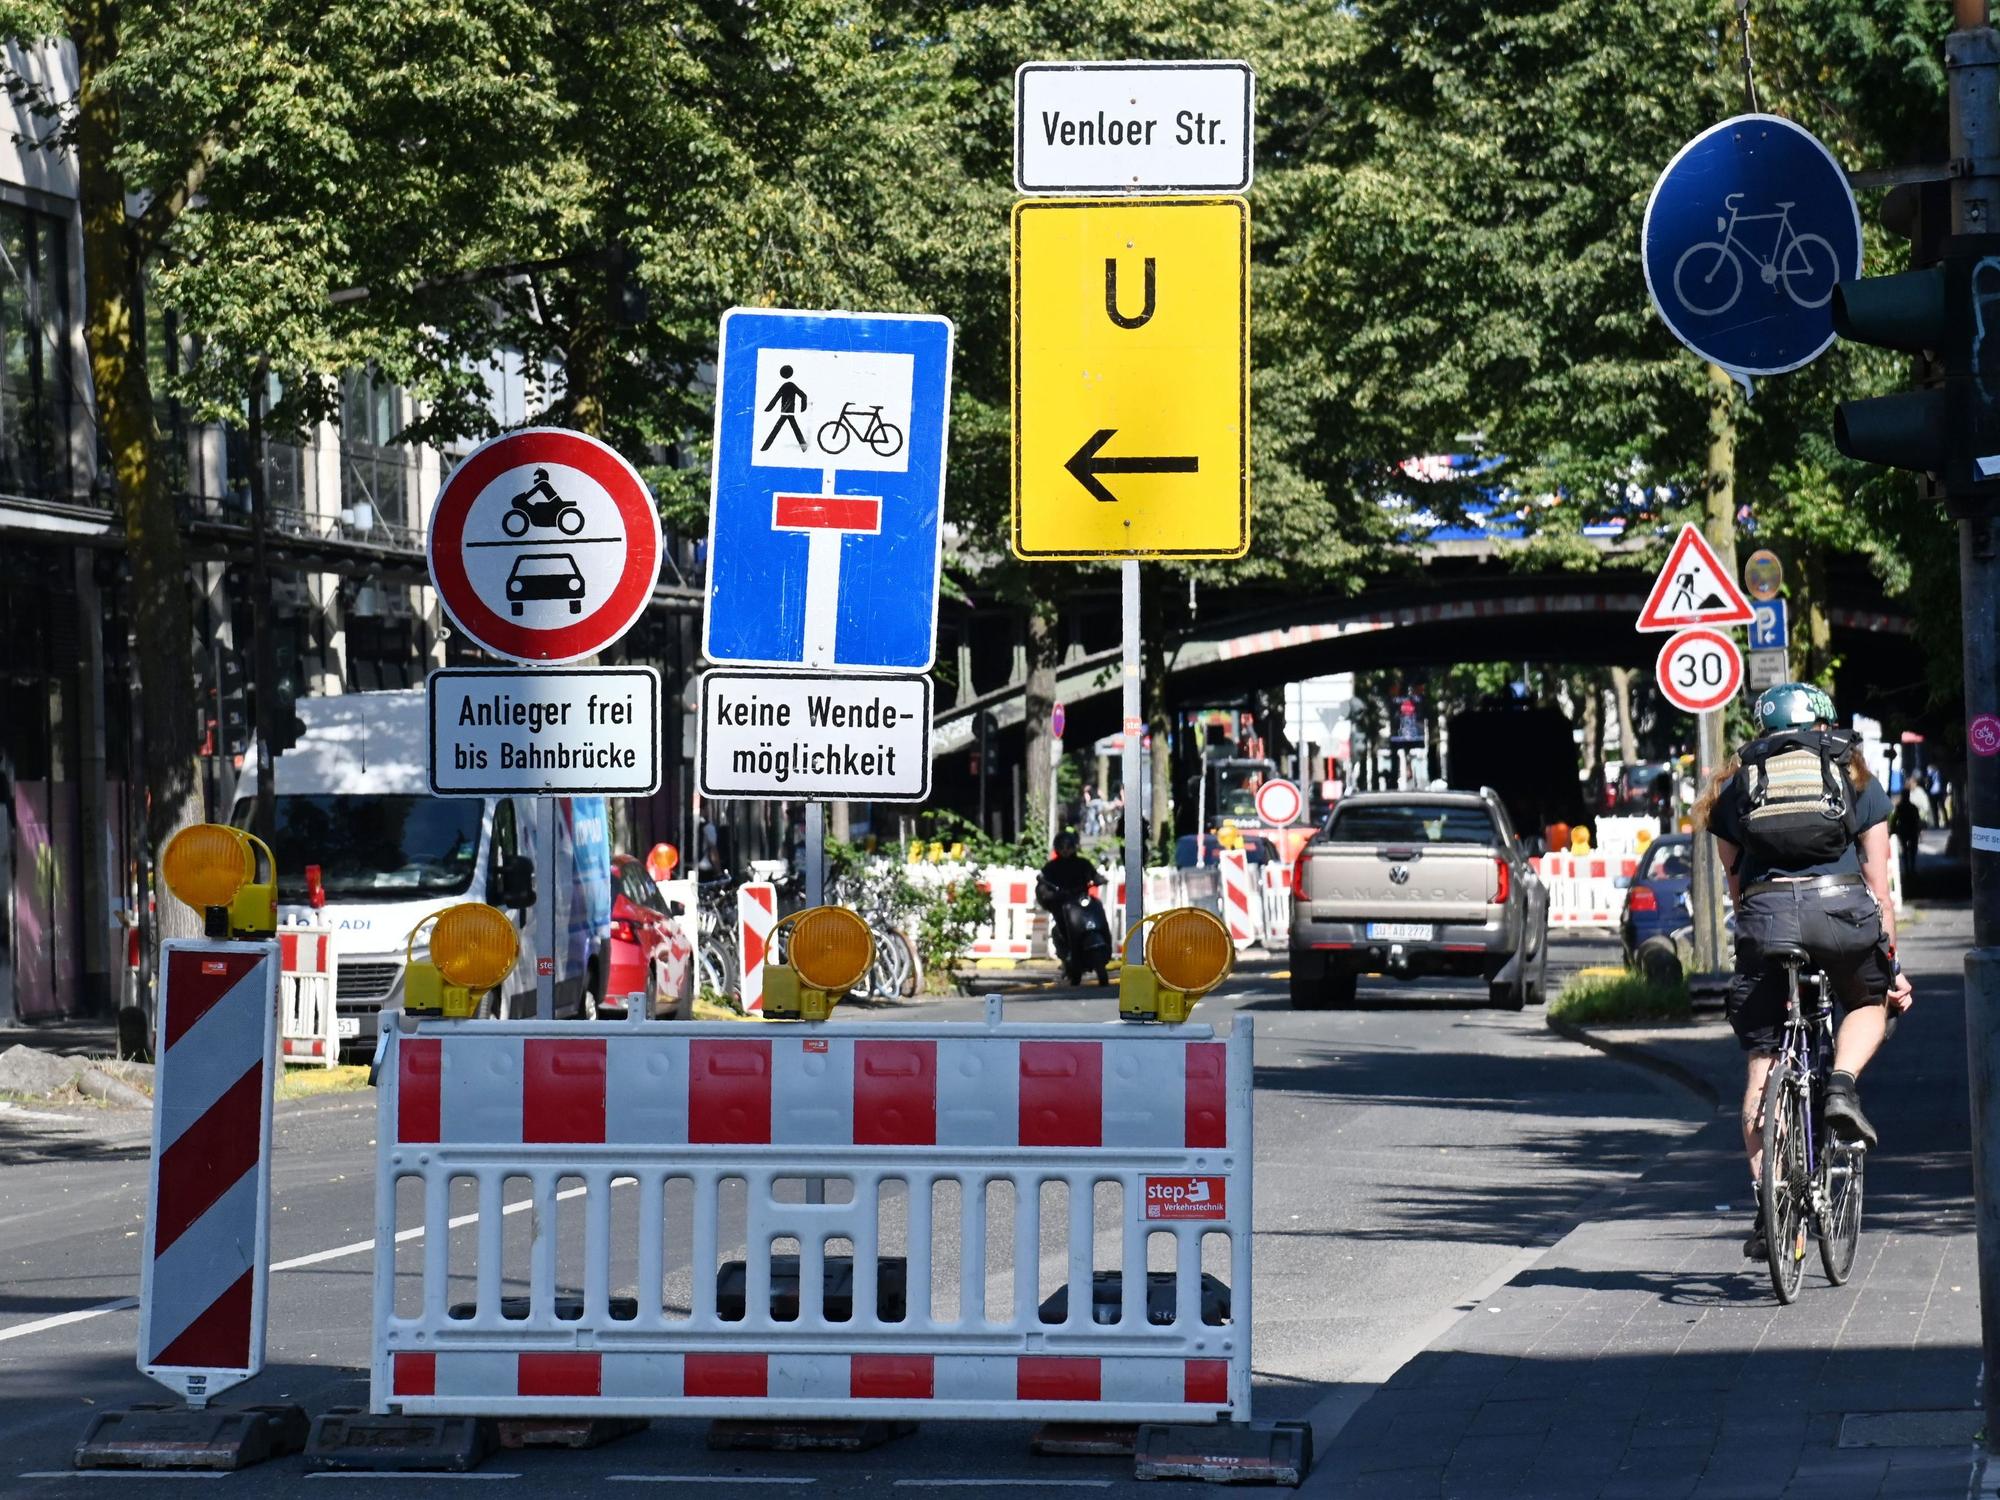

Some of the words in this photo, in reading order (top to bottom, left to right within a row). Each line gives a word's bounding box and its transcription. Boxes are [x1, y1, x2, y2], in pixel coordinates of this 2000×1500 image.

[1042, 111, 1157, 145] Venloer
[1175, 111, 1226, 145] Str.
[1105, 257, 1156, 329] U
[1756, 607, 1776, 645] P
[1677, 652, 1723, 688] 30
[458, 695, 571, 732] Anlieger
[587, 695, 633, 726] frei
[717, 694, 791, 727] keine
[807, 695, 914, 728] Wende-
[453, 742, 488, 770] bis
[500, 742, 636, 770] Bahnbrücke
[733, 742, 896, 782] möglichkeit
[1328, 887, 1471, 901] AMAROK
[1148, 1184, 1185, 1203] step
[1164, 1203, 1224, 1211] Verkehrstechnik
